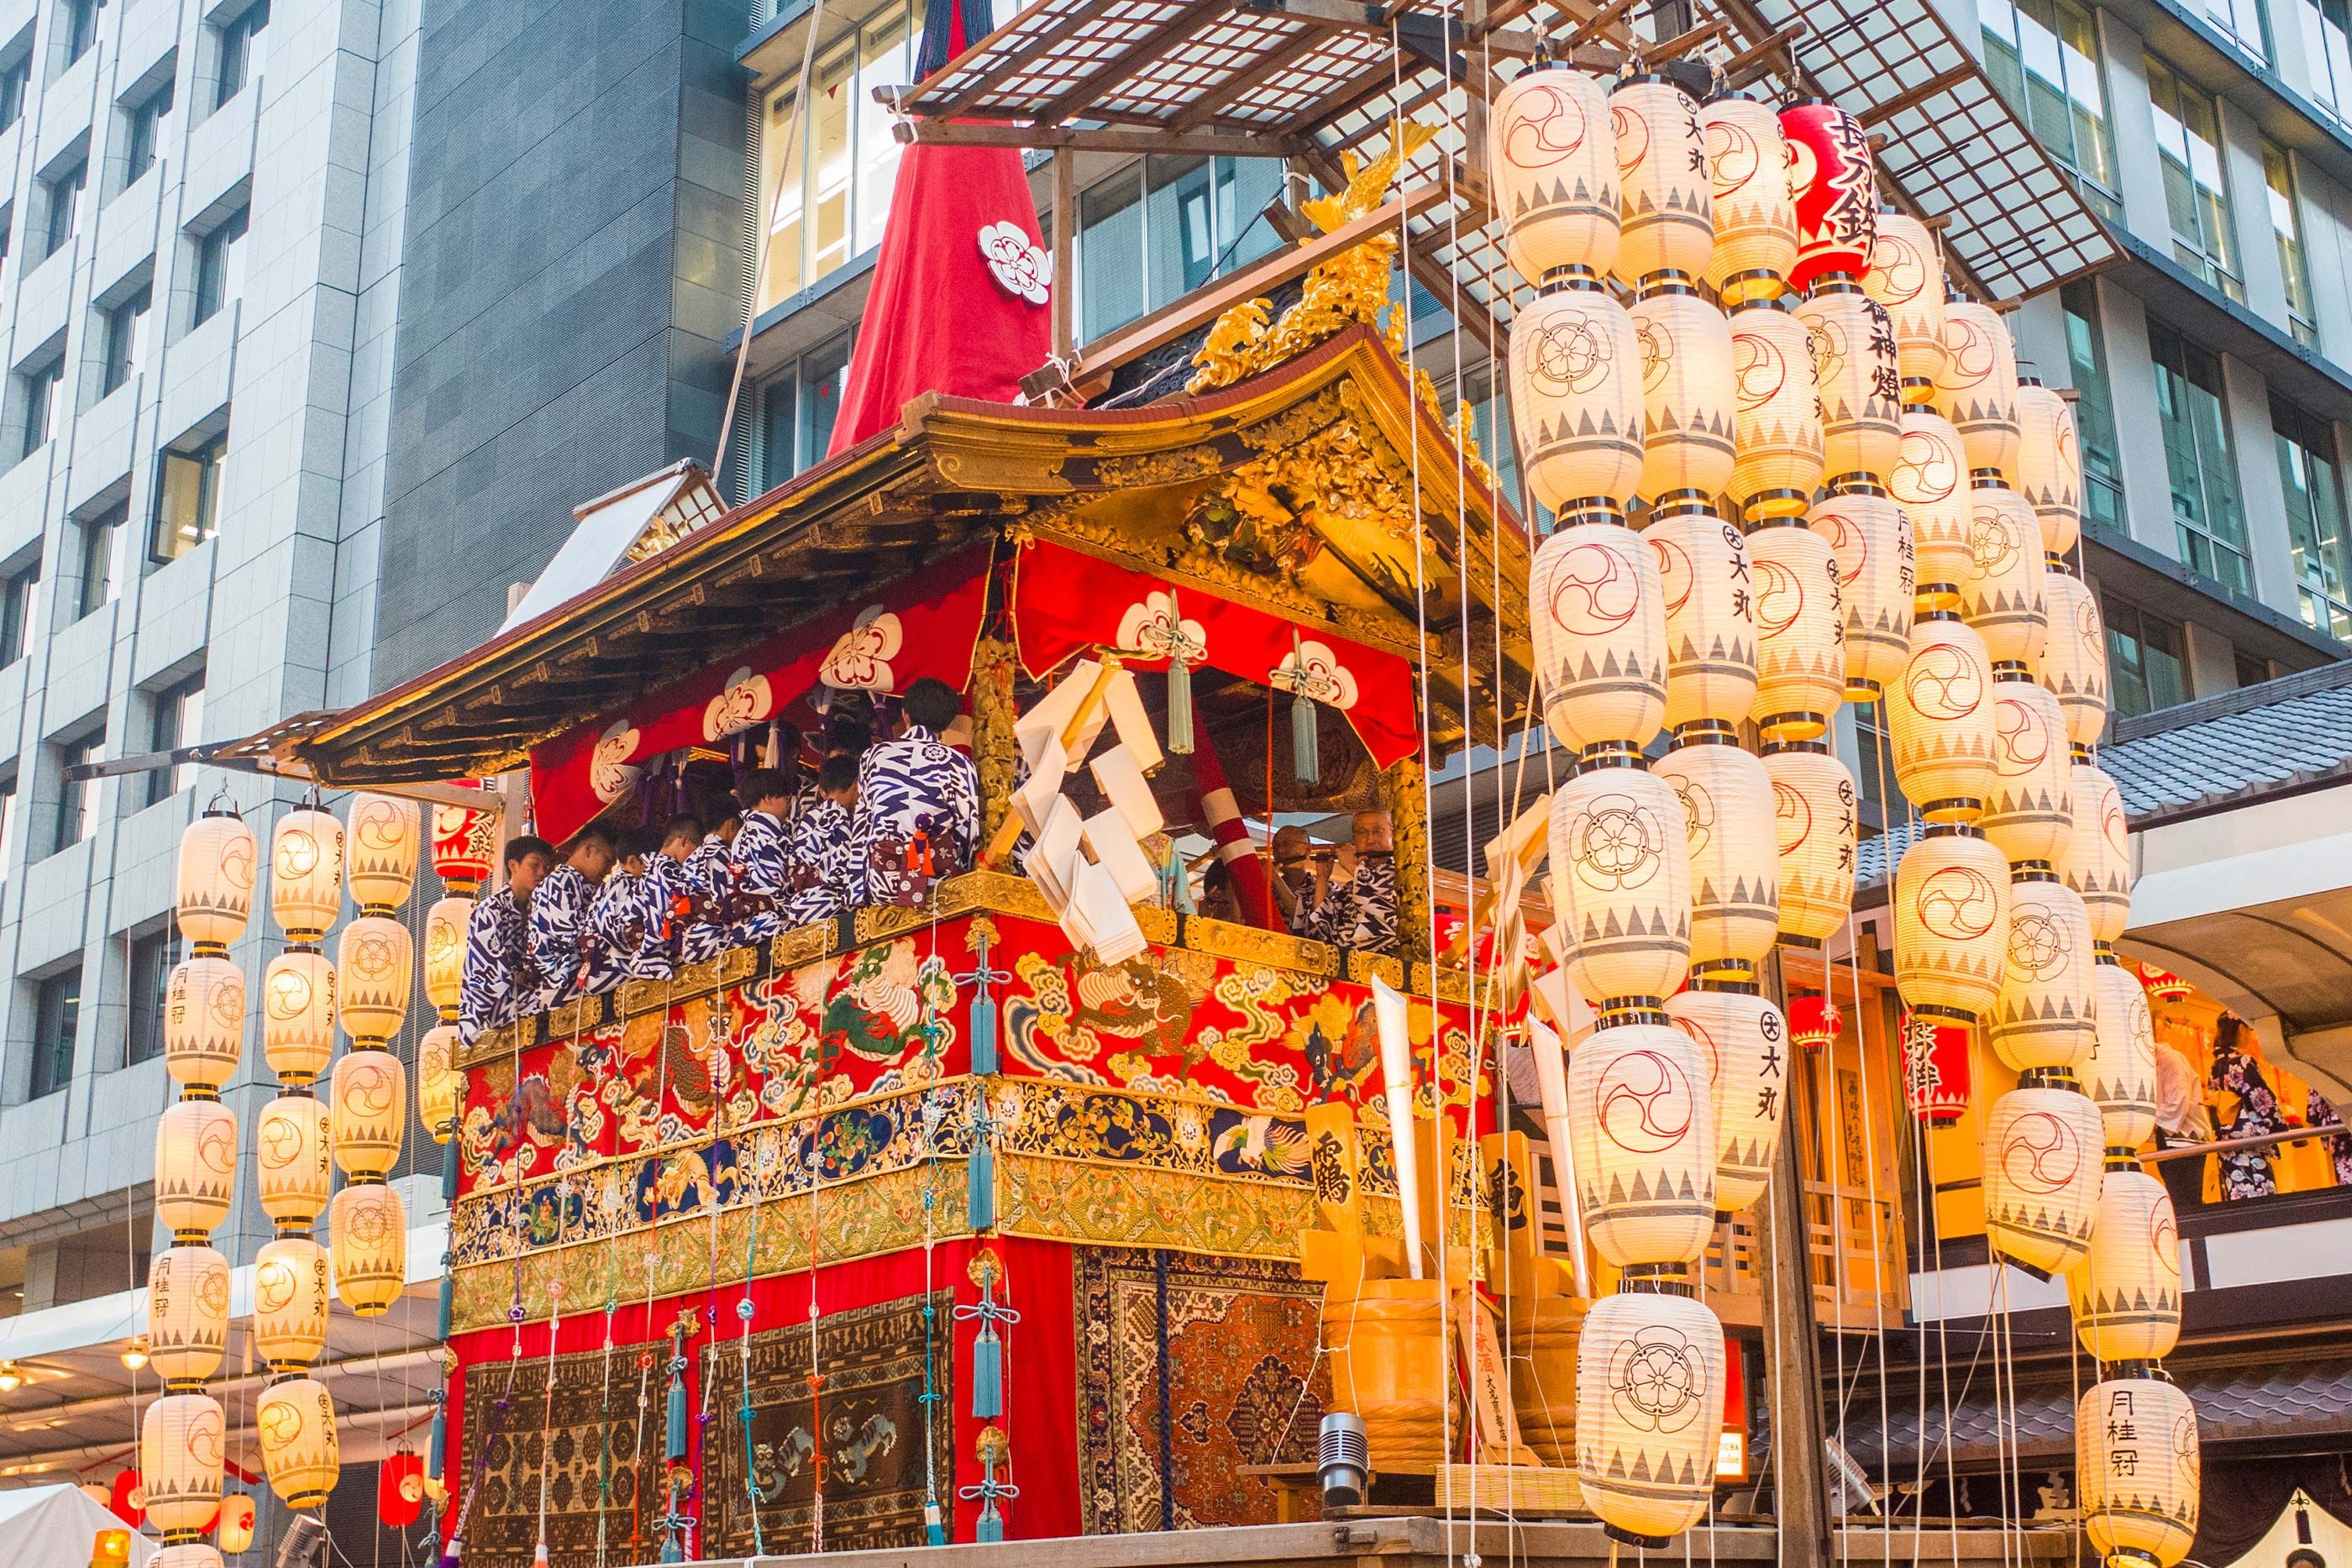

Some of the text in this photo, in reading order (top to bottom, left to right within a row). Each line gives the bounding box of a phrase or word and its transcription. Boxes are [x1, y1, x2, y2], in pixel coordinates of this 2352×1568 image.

[1684, 116, 1707, 181] 大丸
[1829, 107, 1878, 260] 長刀鉾
[1861, 297, 1902, 407] 御神燈
[1897, 509, 1915, 597] 月桂冠
[1728, 553, 1752, 623] 大丸
[1837, 809, 1855, 874] 大丸
[172, 967, 189, 1025] 月桂冠
[1755, 1046, 1781, 1121] 大丸
[319, 1135, 330, 1176] 大丸
[155, 1257, 171, 1319] 月桂冠
[313, 1277, 325, 1318] 大丸
[321, 1411, 336, 1447] 大丸
[2107, 1390, 2139, 1478] 月桂冠
